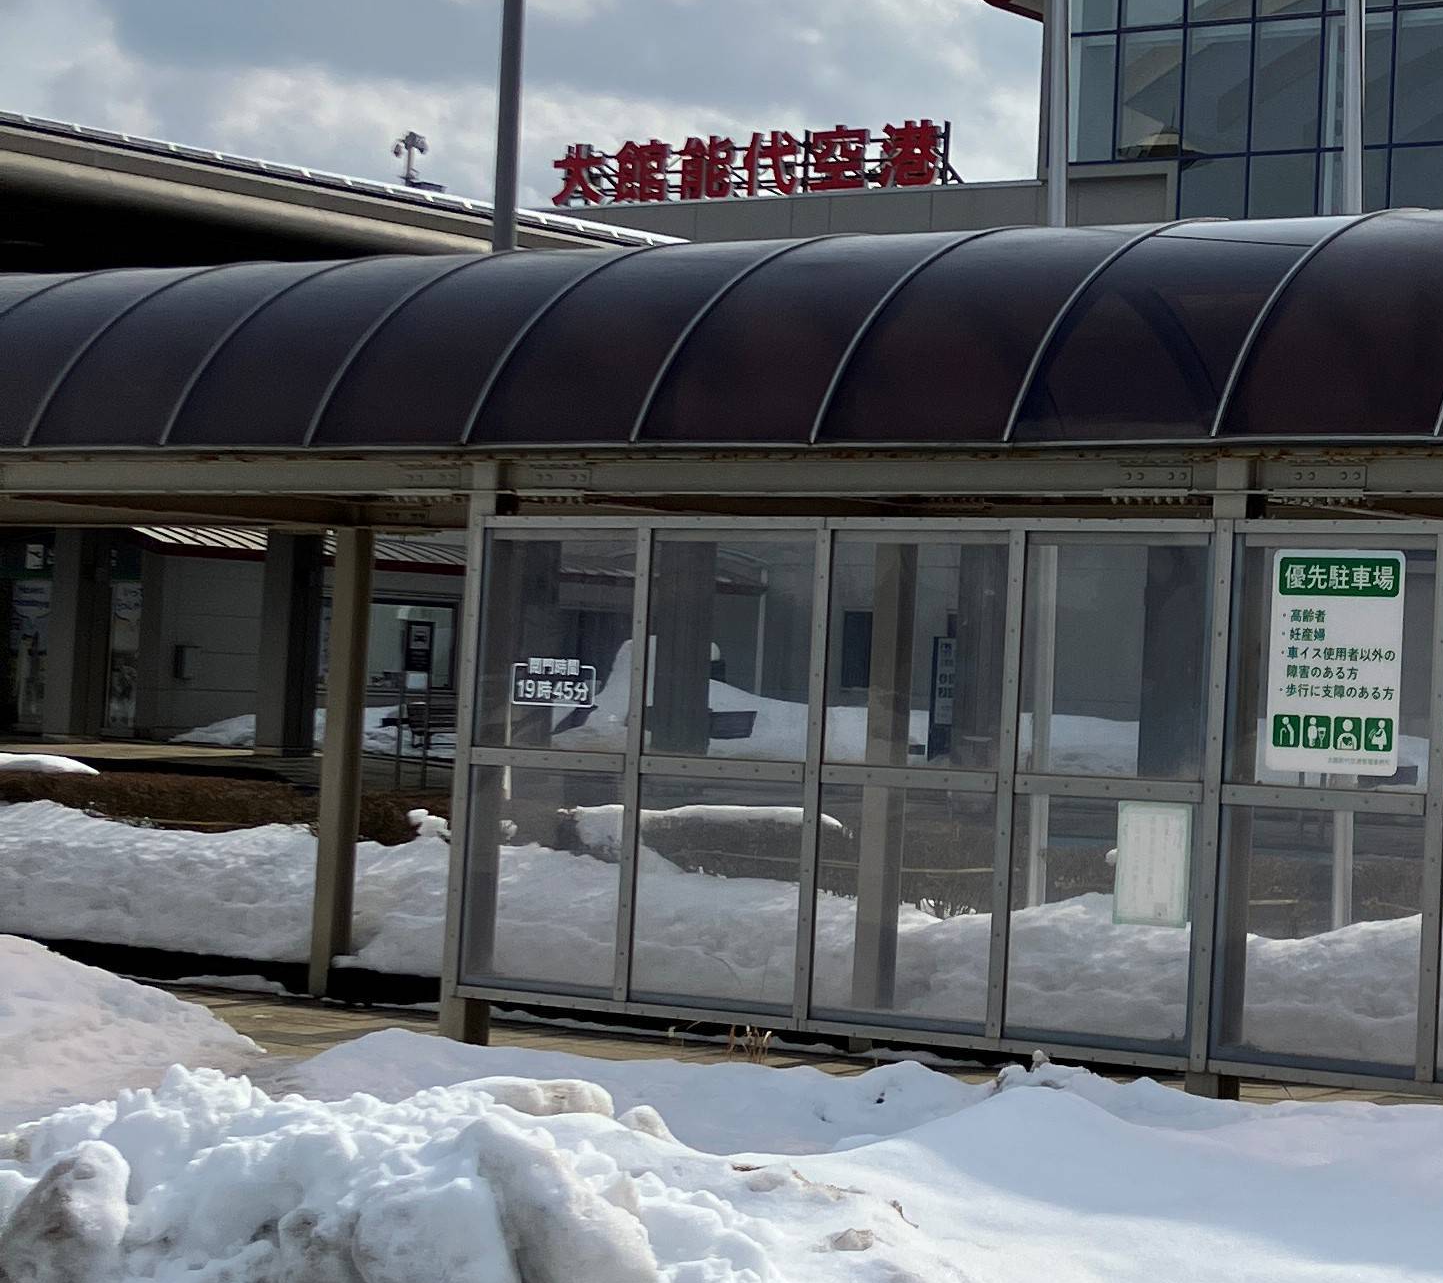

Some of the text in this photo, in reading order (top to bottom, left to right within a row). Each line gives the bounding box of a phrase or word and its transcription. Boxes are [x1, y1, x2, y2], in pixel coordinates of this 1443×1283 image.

[552, 119, 941, 205] 大館能代空港
[1285, 564, 1395, 591] 優先駐車場
[1286, 664, 1359, 681] 障害のある方
[517, 679, 589, 702] 19時45分
